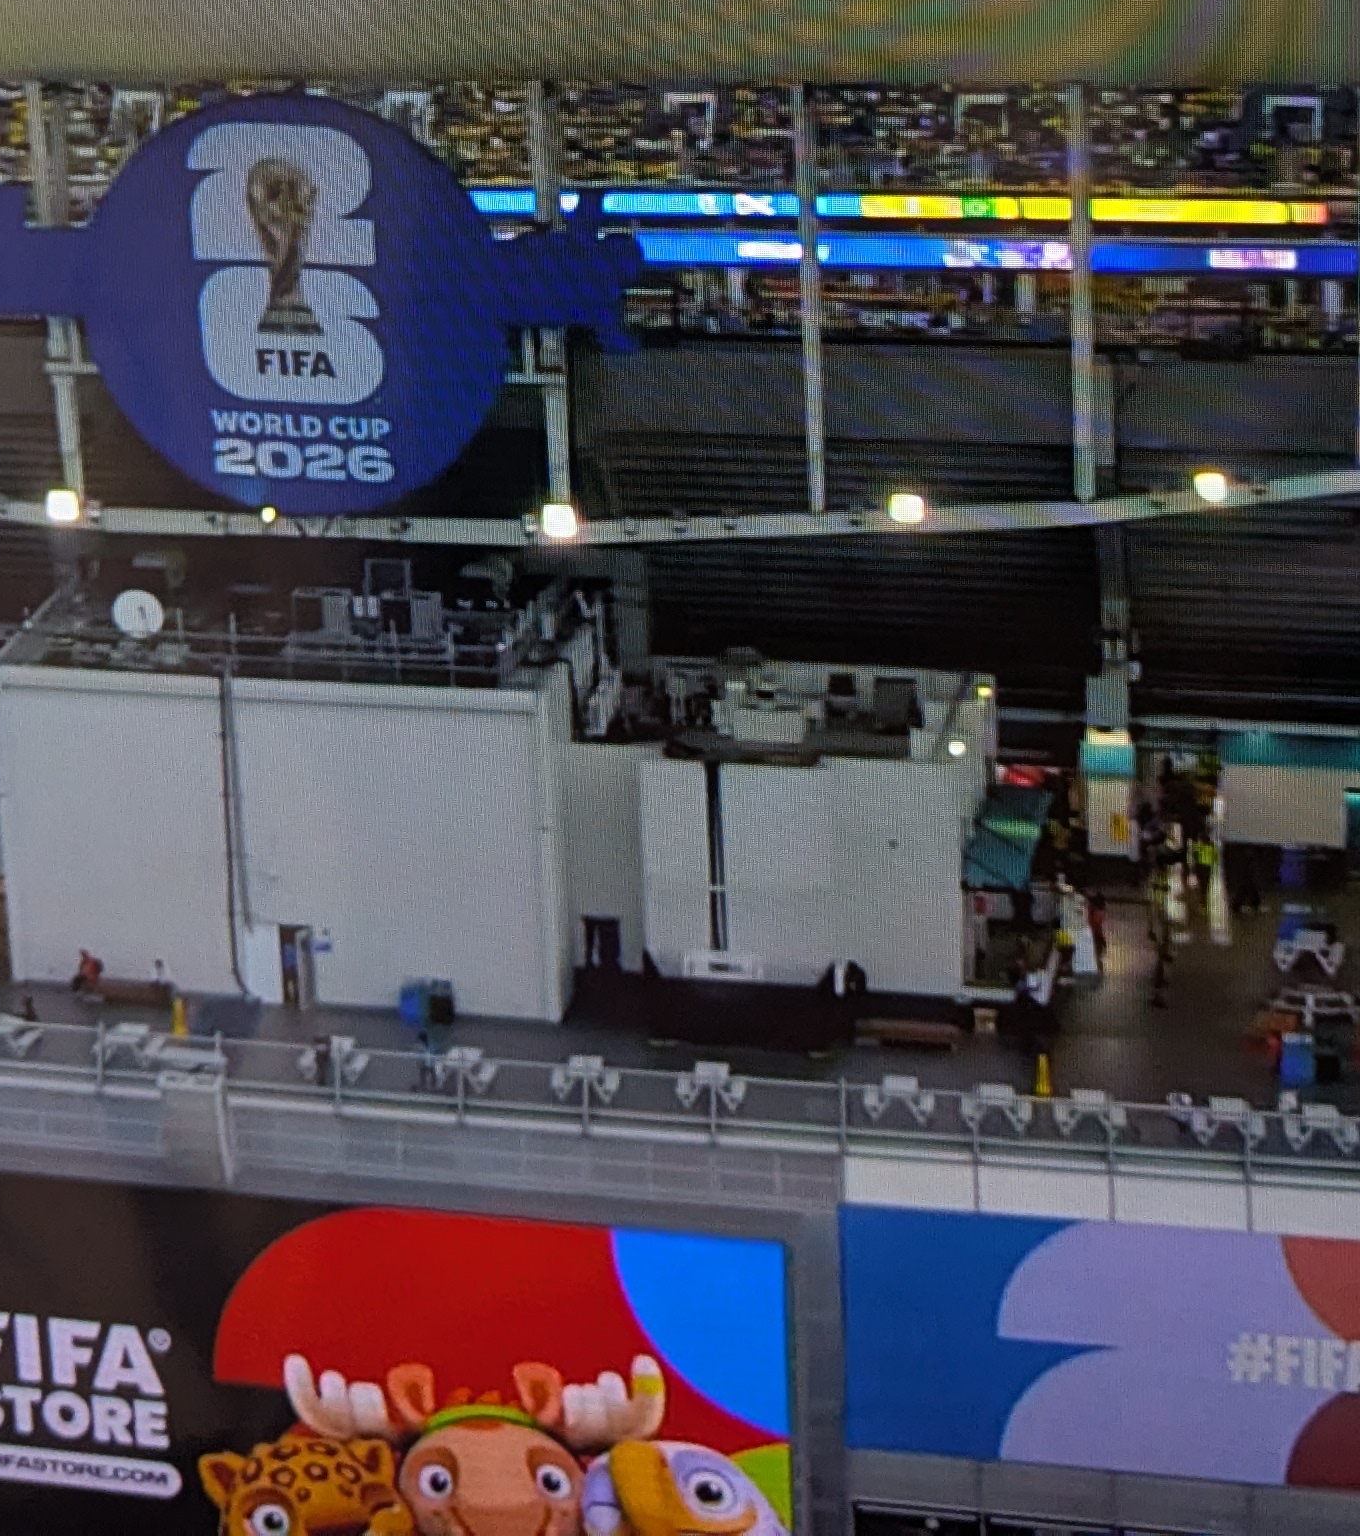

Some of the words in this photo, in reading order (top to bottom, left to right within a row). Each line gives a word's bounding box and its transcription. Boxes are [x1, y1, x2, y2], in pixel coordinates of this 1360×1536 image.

[256, 349, 337, 378] FIFA
[210, 409, 323, 438] WORLD
[328, 415, 392, 441] CUP
[213, 437, 396, 483] 2026
